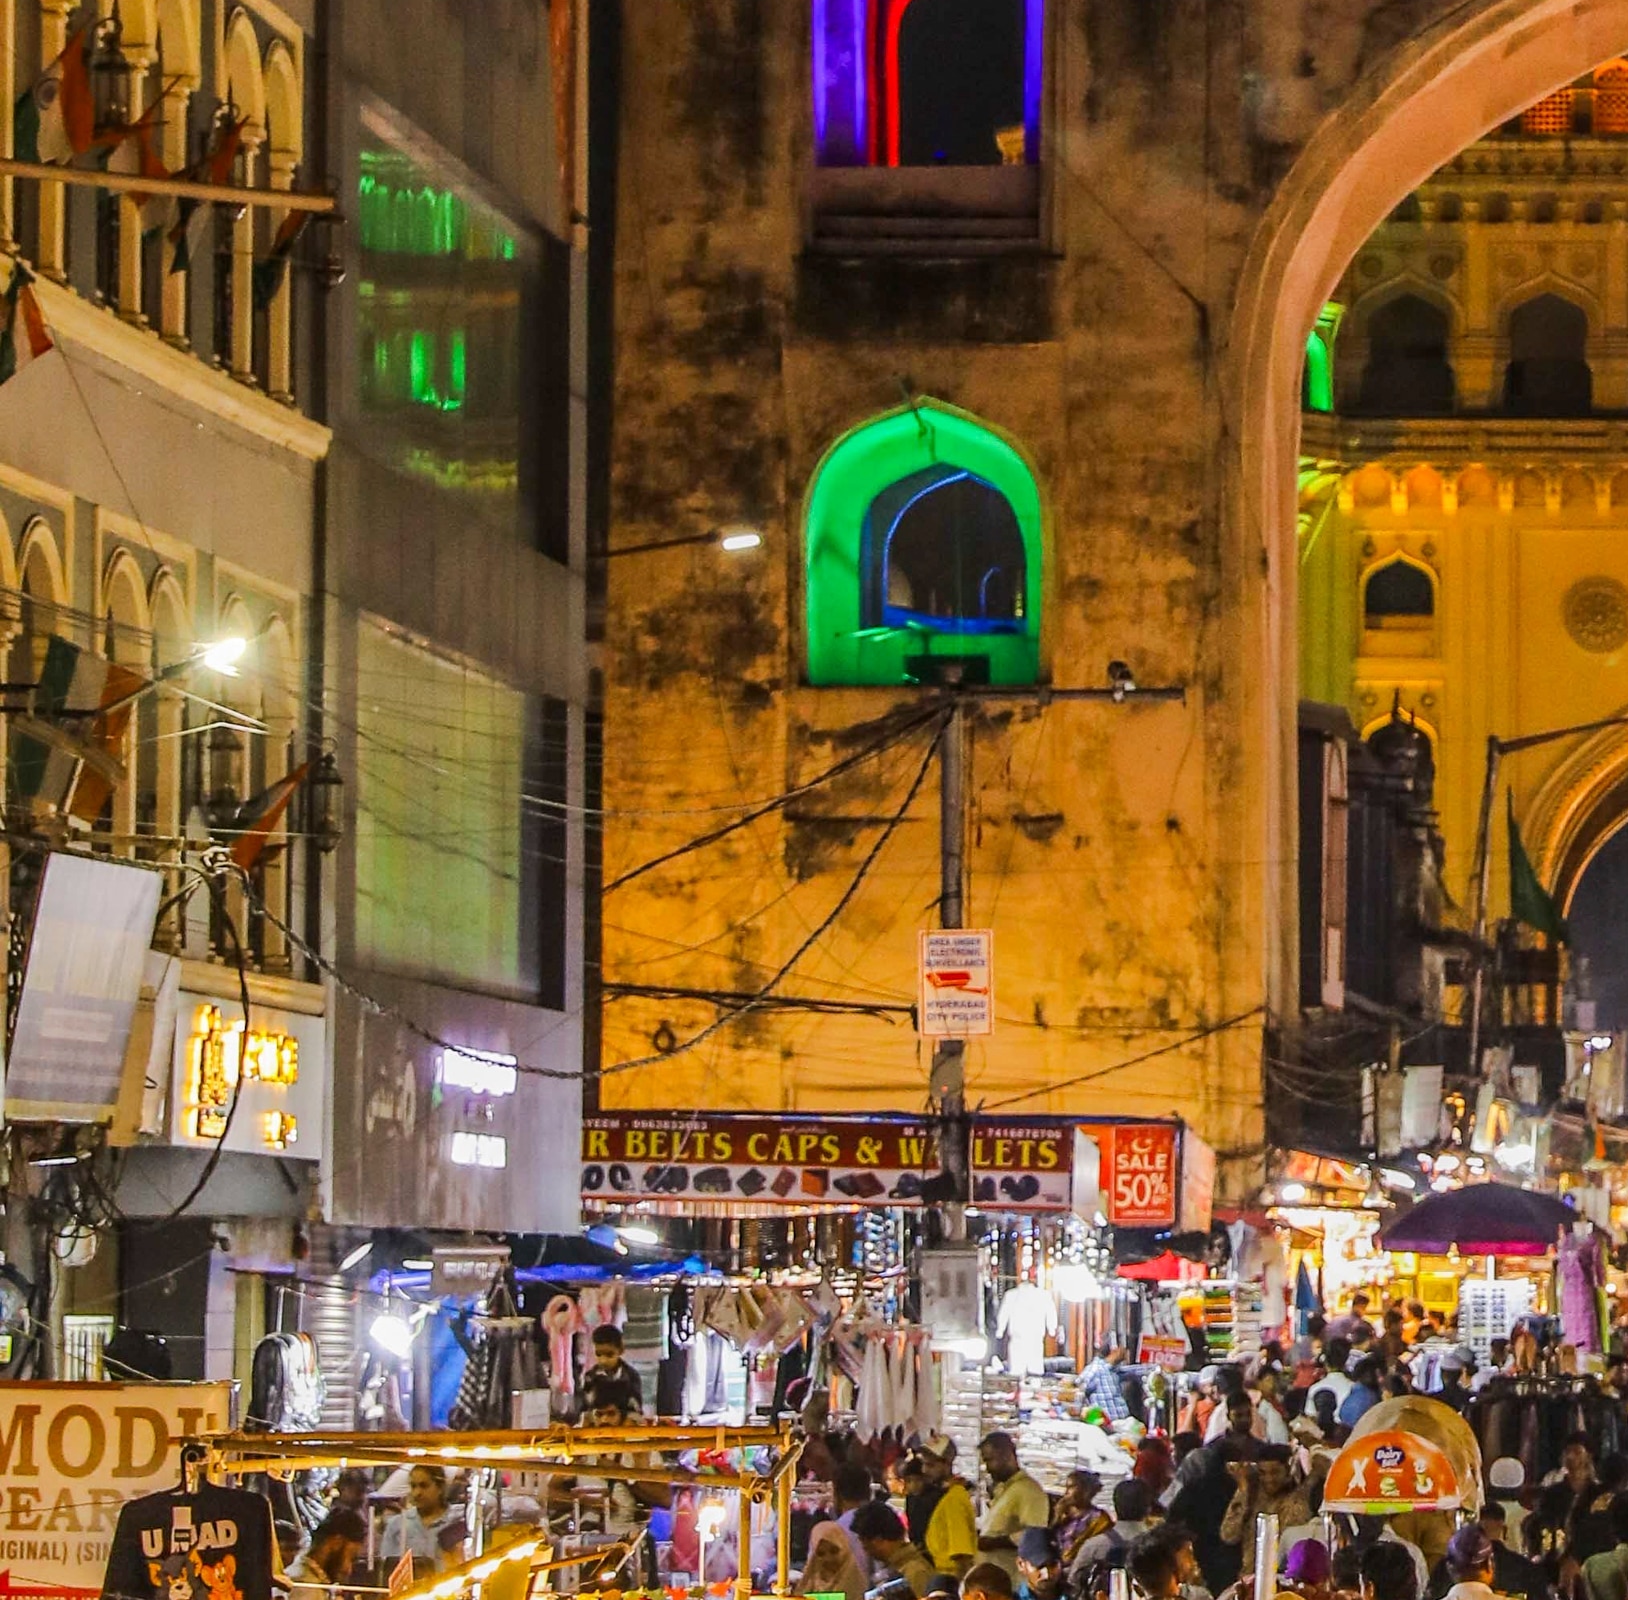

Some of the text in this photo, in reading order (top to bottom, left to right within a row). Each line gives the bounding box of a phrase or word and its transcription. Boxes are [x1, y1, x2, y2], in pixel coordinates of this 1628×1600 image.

[625, 1131, 733, 1162] BELTS
[747, 1132, 840, 1164] CAPS
[855, 1136, 882, 1165] &
[898, 1137, 1059, 1168] WLETS
[1116, 1153, 1167, 1171] SALE
[1115, 1173, 1168, 1208] 50%
[0, 1486, 142, 1532] EAR
[141, 1519, 238, 1558] U AD
